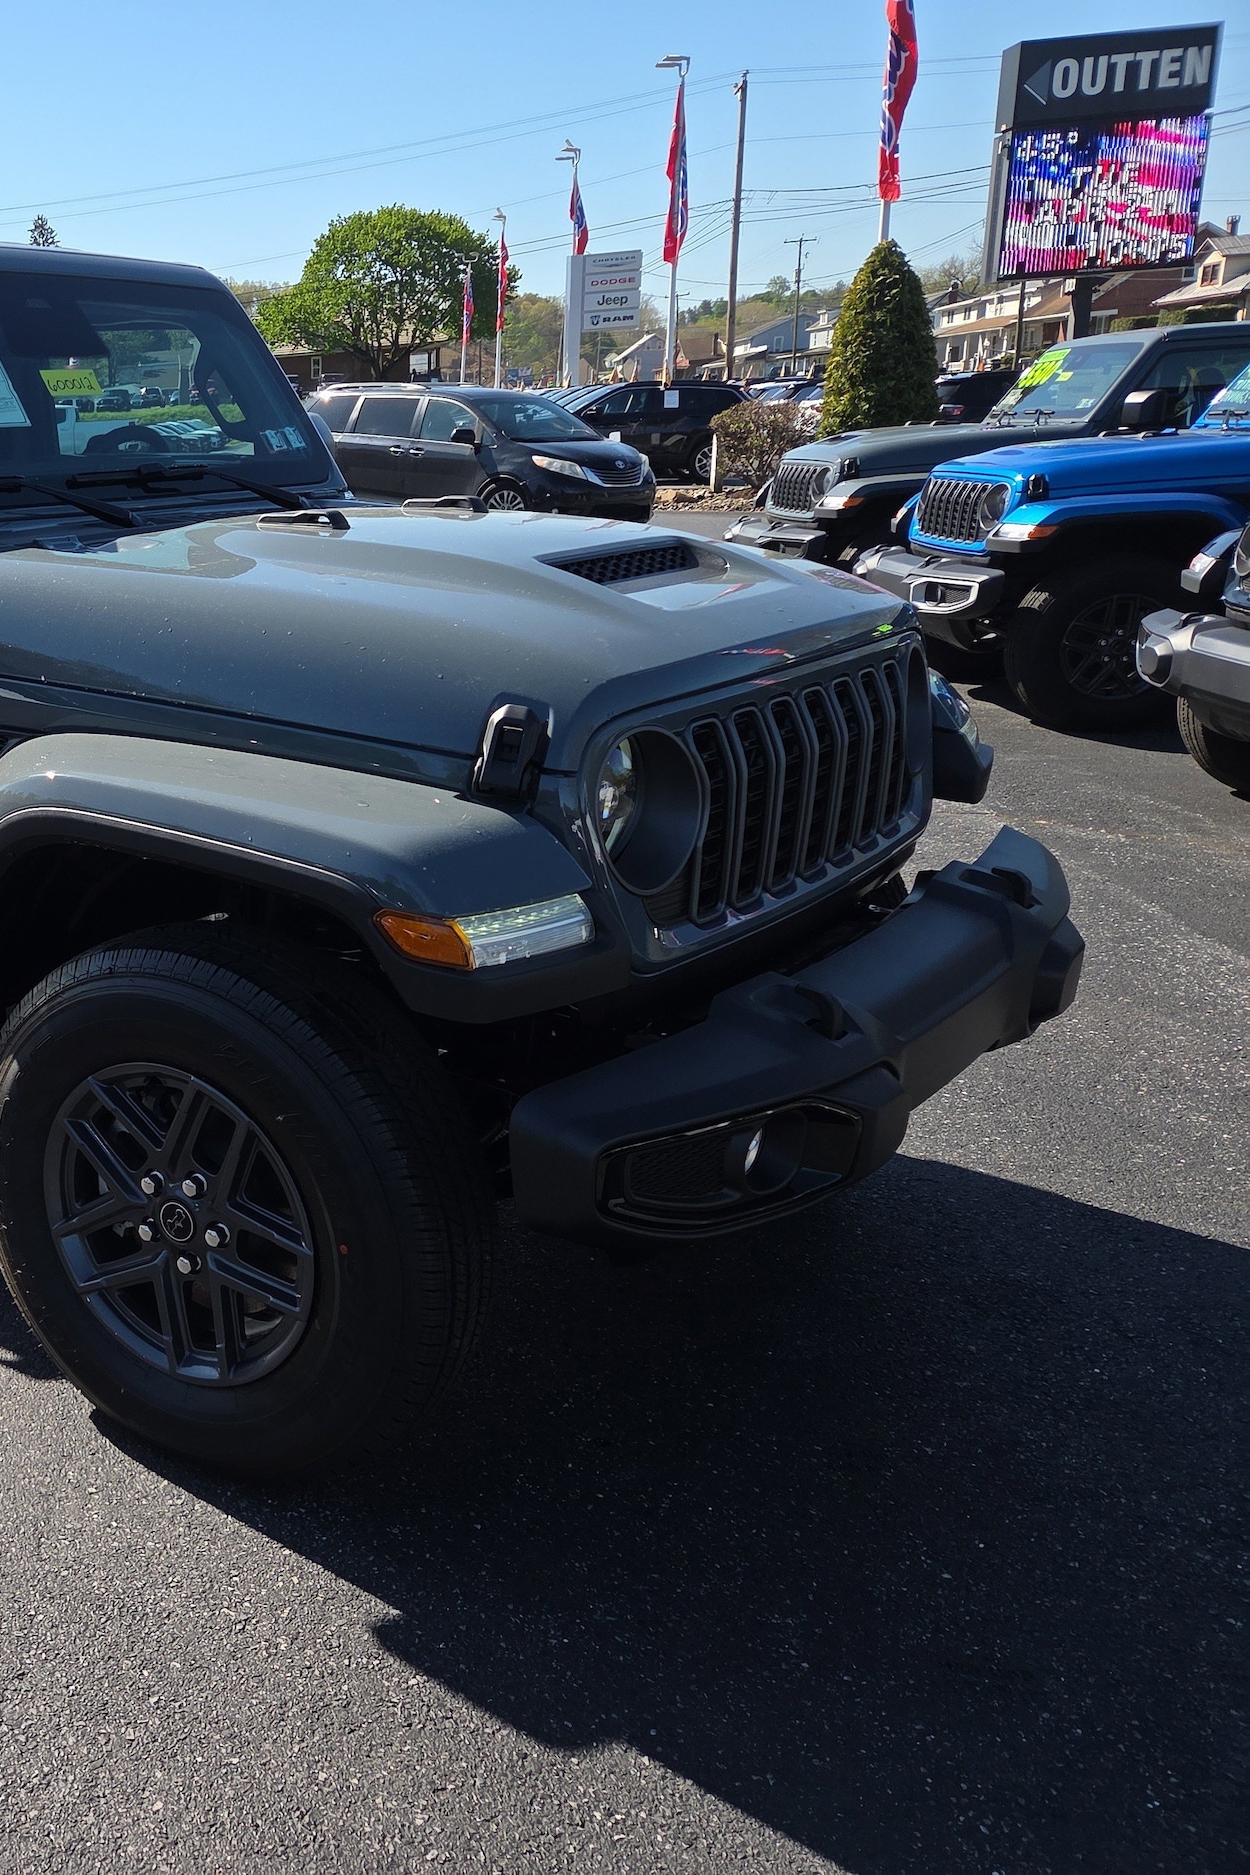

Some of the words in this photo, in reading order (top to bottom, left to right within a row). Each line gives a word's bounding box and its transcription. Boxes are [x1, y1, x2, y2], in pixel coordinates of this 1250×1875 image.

[1052, 45, 1213, 99] OUTTEN
[590, 277, 636, 286] DODGE
[597, 294, 628, 306] Jeep
[47, 376, 96, 392] 600012
